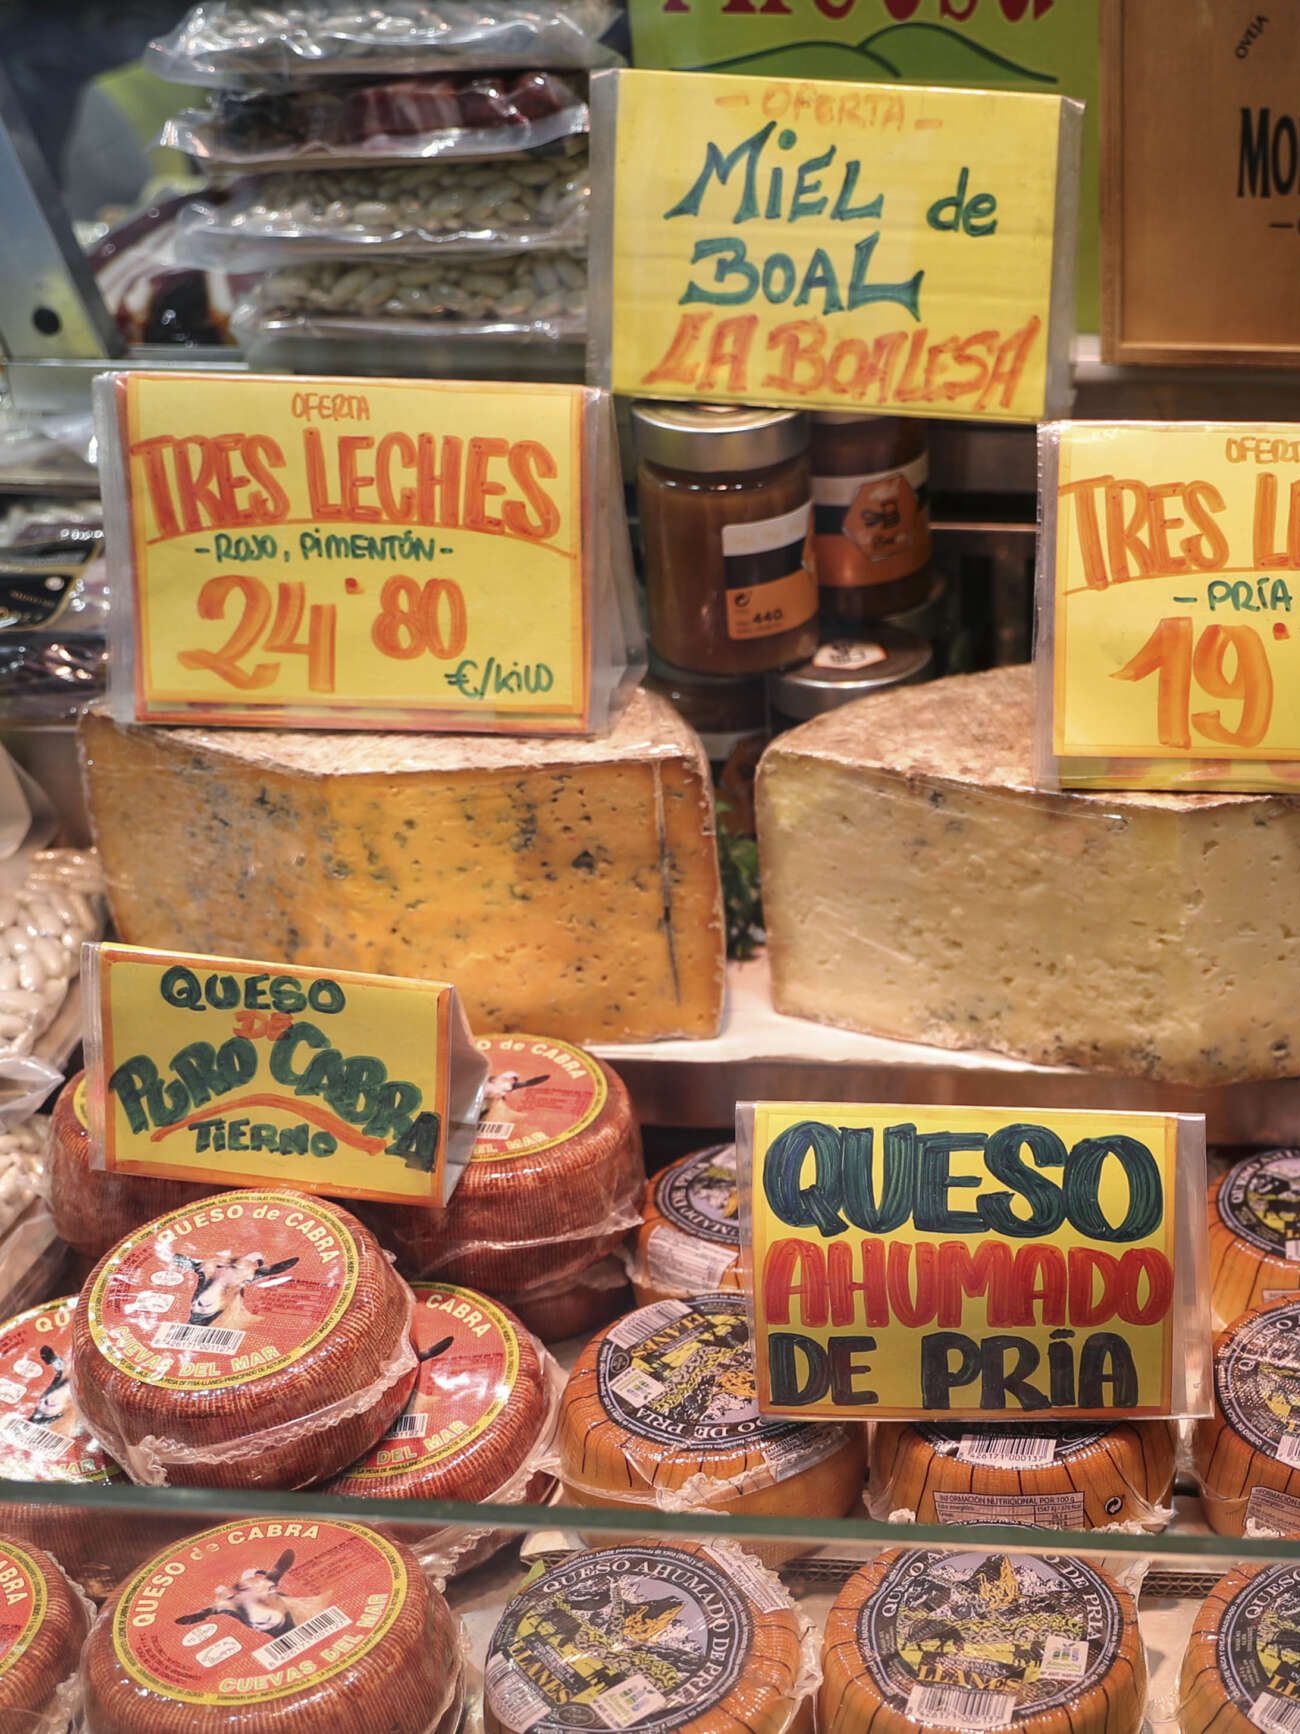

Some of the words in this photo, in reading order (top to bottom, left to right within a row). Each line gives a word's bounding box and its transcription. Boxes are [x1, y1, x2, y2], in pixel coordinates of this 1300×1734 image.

[1234, 14, 1269, 60] OVEJA
[761, 82, 907, 131] OFERTA
[927, 167, 998, 236] de
[678, 231, 925, 321] BOAL
[641, 312, 760, 393] LA
[291, 391, 370, 421] OFERTA
[130, 433, 290, 542] TRES
[303, 428, 562, 540] LECHES
[1058, 474, 1230, 590] TRES
[160, 965, 346, 1014] QUESO
[232, 1010, 294, 1042] DE
[500, 1039, 526, 1052] de
[530, 1041, 587, 1080] CABRA
[108, 1037, 258, 1135] PURO
[269, 1022, 442, 1173] CABRA
[188, 1119, 338, 1158] TIERNO
[762, 1120, 1164, 1243] QUESO
[157, 1204, 243, 1245] QUESO
[252, 1205, 280, 1221] de
[284, 1212, 340, 1264] CABRA
[764, 1237, 1174, 1329] AHUMADO
[425, 1294, 493, 1339] CABRA
[631, 1313, 707, 1358] LLANES
[179, 1357, 221, 1377] DEL
[231, 1346, 281, 1372] MAR
[768, 1332, 879, 1407] DE
[376, 1446, 418, 1464] DEL
[423, 1420, 469, 1450] MAR
[633, 1407, 687, 1436] PRIA
[693, 1426, 729, 1439] DE
[0, 1559, 28, 1605] ABRA
[133, 1561, 186, 1627] QUESO
[227, 1523, 320, 1546] CABRA
[543, 1559, 632, 1593] QUESO
[634, 1559, 730, 1633] AHUMADO
[1061, 1566, 1090, 1589] DE
[1082, 1593, 1103, 1641] PRIA
[219, 1659, 316, 1693] CUEVAS
[320, 1632, 364, 1663] DEL
[356, 1593, 389, 1629] MAR
[713, 1634, 730, 1664] DE
[506, 1643, 573, 1705] LLANES
[669, 1664, 723, 1708] PRIA
[916, 1666, 1027, 1690] LLANES
